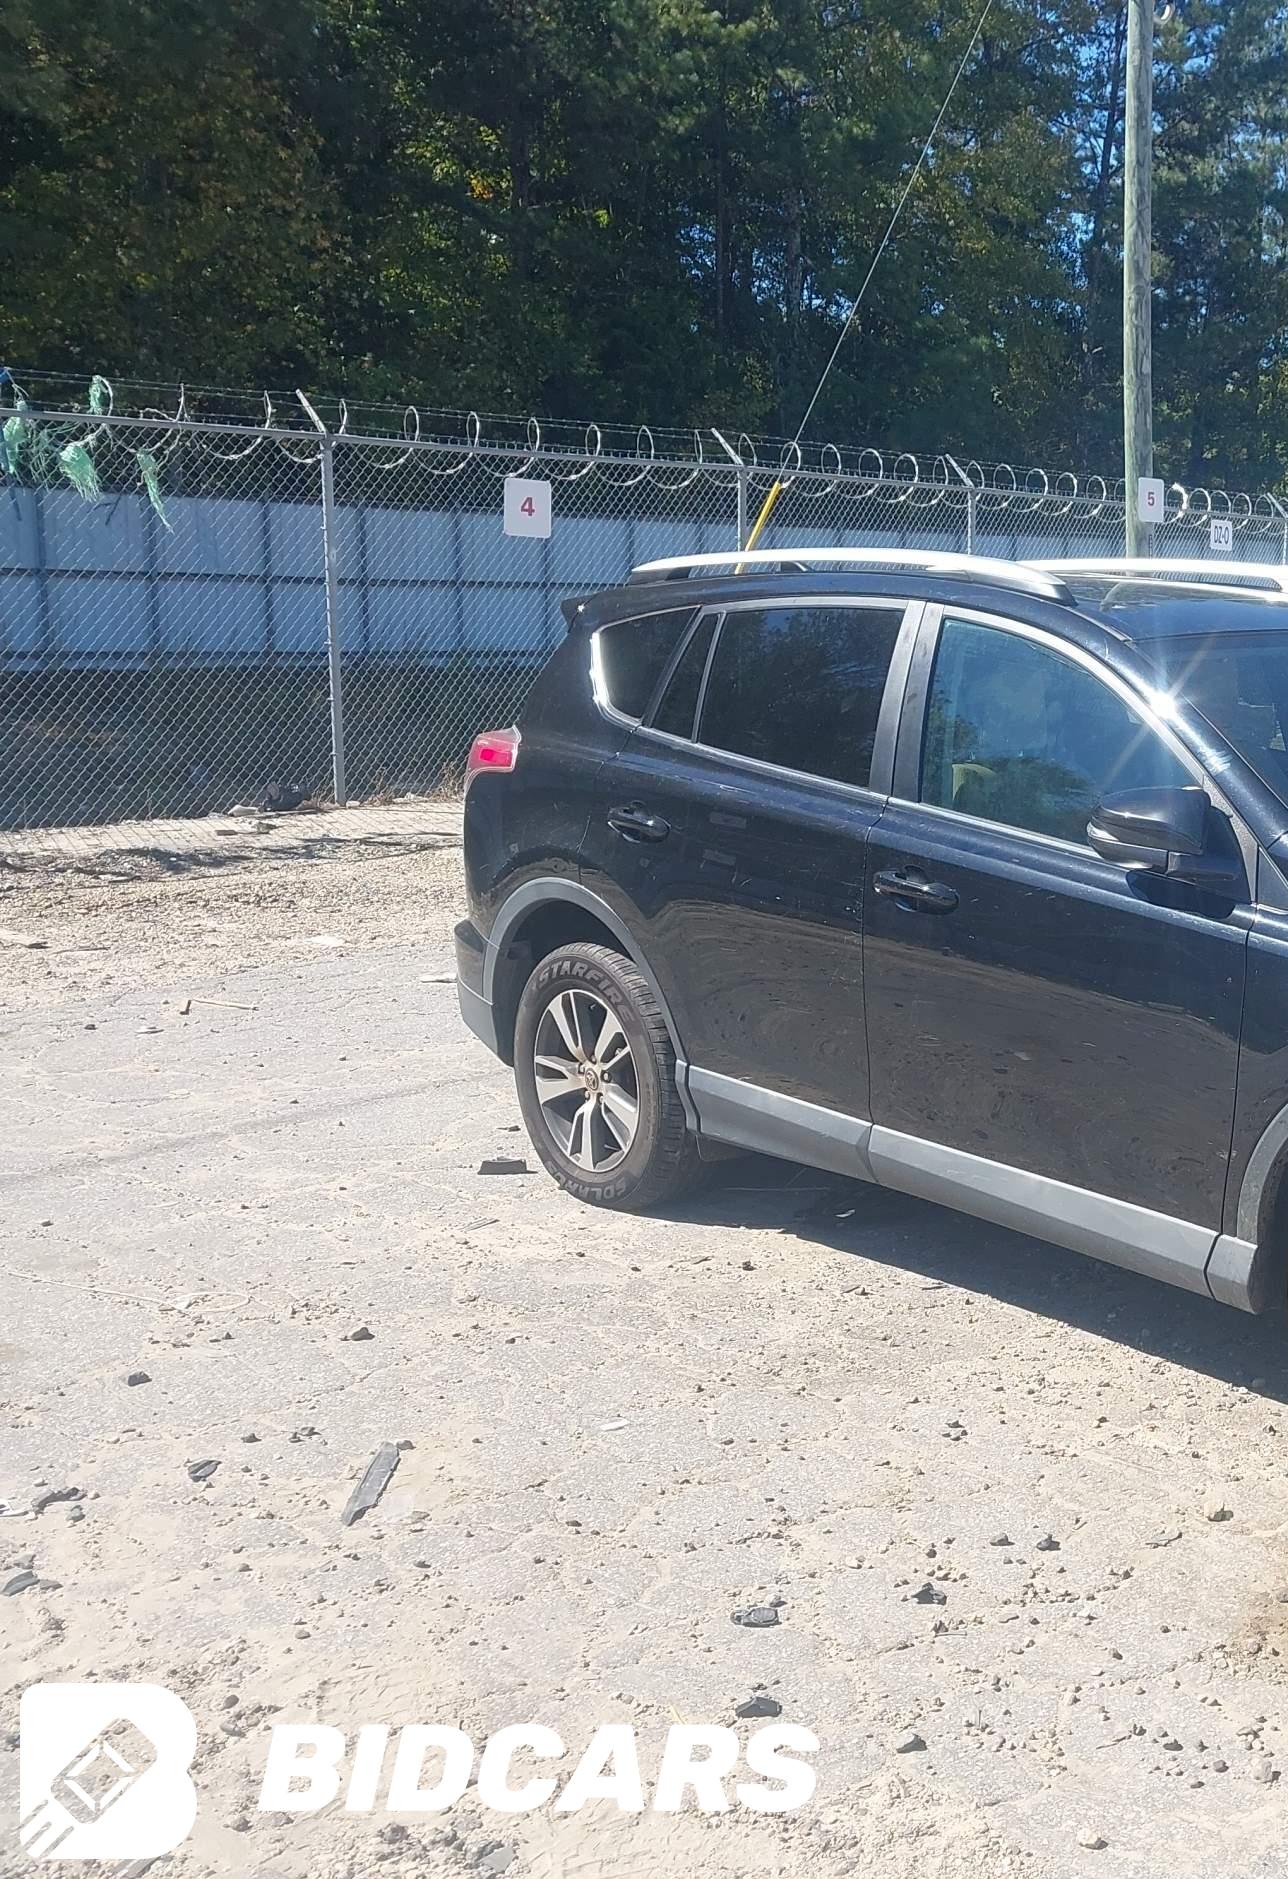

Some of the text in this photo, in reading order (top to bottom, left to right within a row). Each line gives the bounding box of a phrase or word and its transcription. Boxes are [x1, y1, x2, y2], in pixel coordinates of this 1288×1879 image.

[520, 496, 536, 517] 4
[1147, 491, 1155, 507] 5
[538, 960, 636, 1022] STARFIRE
